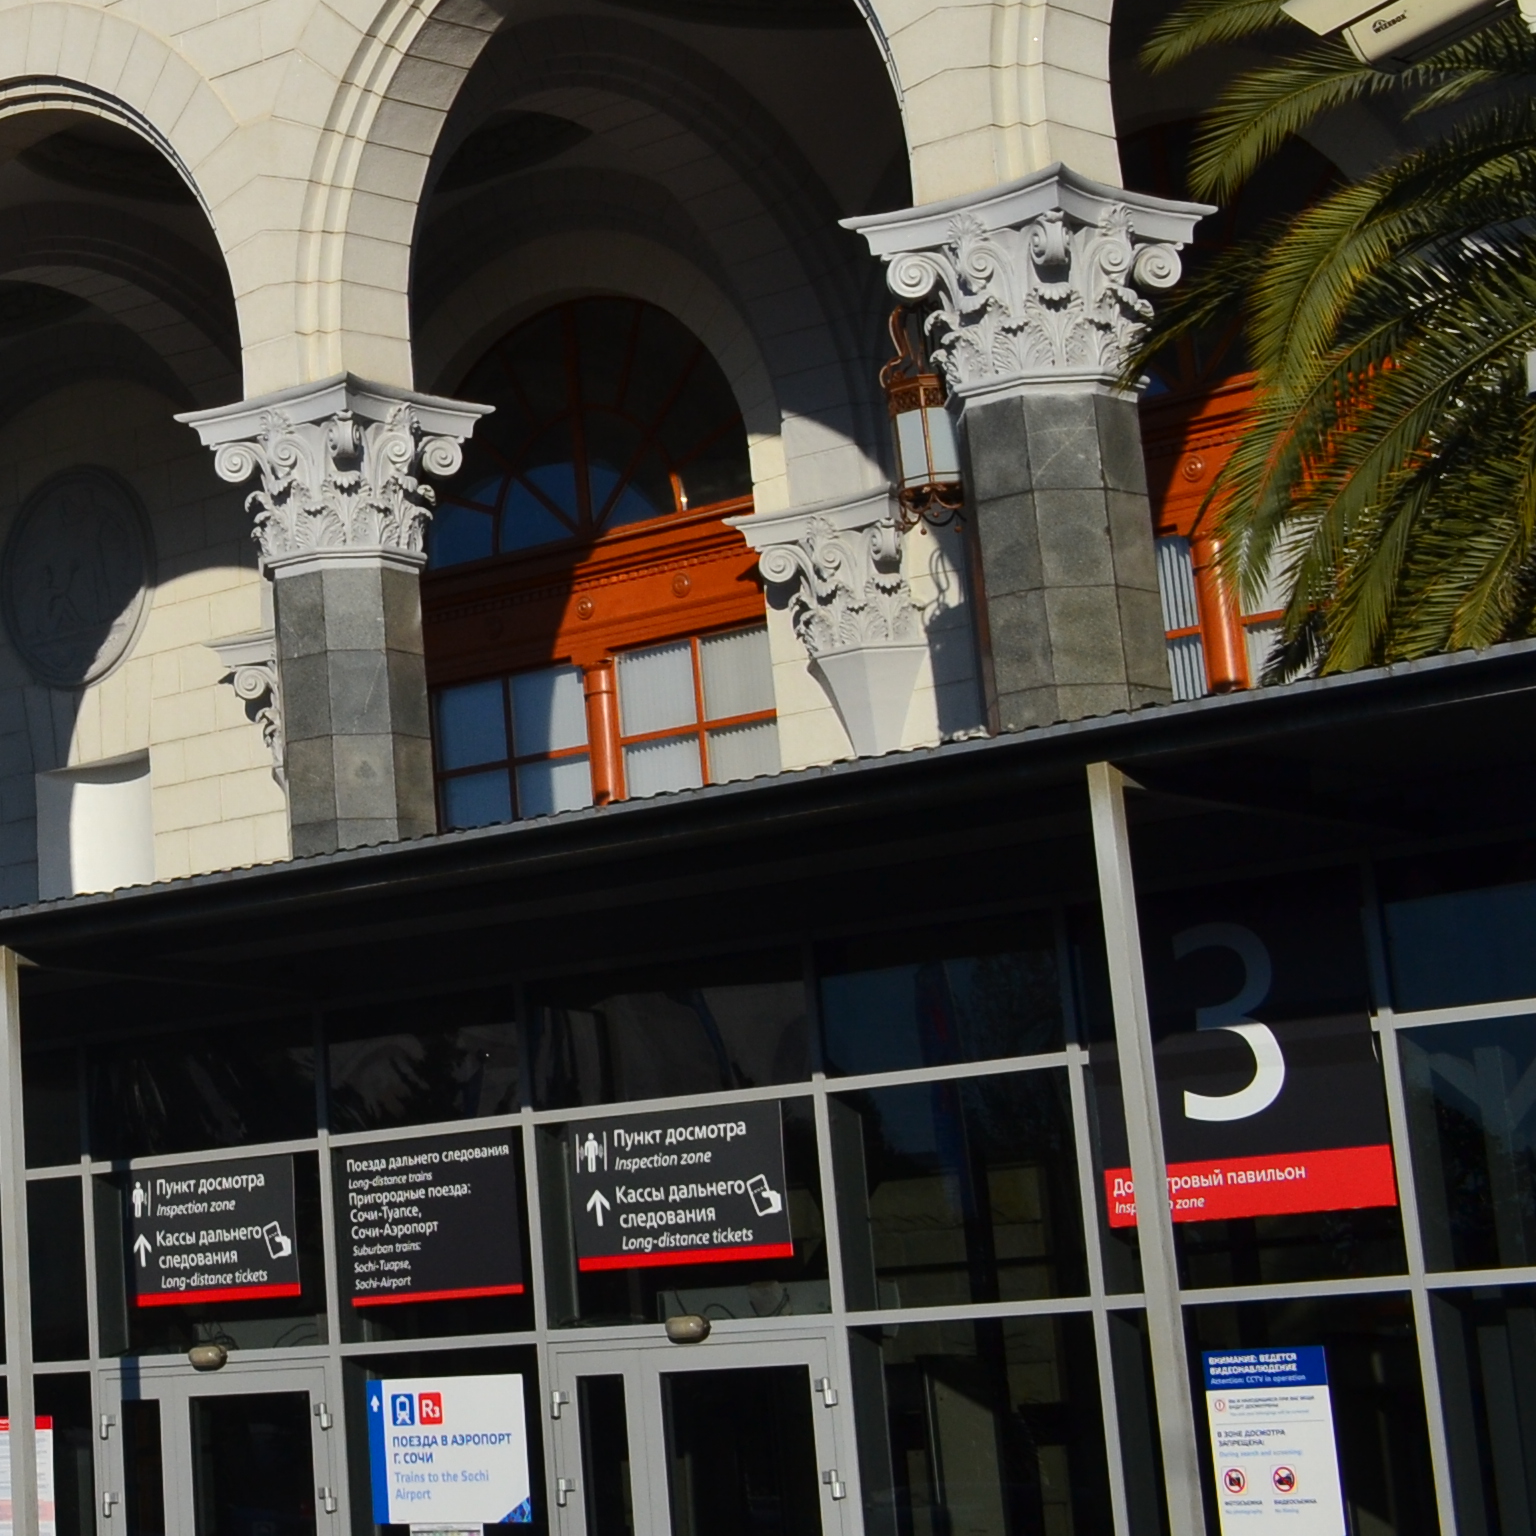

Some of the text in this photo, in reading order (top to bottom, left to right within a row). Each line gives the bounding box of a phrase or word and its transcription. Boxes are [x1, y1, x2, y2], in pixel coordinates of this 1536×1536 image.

[1172, 921, 1286, 1122] 3
[614, 1121, 746, 1151] Пункт досмотра
[346, 1144, 509, 1173] Поезда дальнего следования
[615, 1151, 712, 1173] Inspection zone
[348, 1171, 433, 1190] Long-distance trains
[1227, 1165, 1306, 1185] павильон
[156, 1173, 265, 1199] Пункт досмотра
[349, 1183, 472, 1207] Пригородные поезда:
[616, 1179, 745, 1204] Кассы дальнего
[156, 1199, 236, 1218] Inspection zone
[1176, 1196, 1205, 1210] zone
[350, 1205, 422, 1223] Сочи-Туапсе,
[619, 1207, 716, 1229] следования
[156, 1225, 262, 1246] Кассы дальнего
[351, 1220, 439, 1239] Сочи-Аэропорт
[353, 1241, 422, 1257] Suburban trains:
[622, 1227, 753, 1252] Long-distance tickets
[159, 1250, 238, 1269] следования
[354, 1259, 411, 1274] Sochi-Tuapse,
[161, 1269, 268, 1290] Long-distance tickets
[355, 1276, 412, 1290] Sochi-Airport
[422, 1400, 440, 1418] R3
[393, 1433, 512, 1448] ПОЕЗДА В АЭРОПОРТ
[394, 1452, 433, 1464] Г. СОЧИ
[395, 1470, 489, 1483] Trains to the Sochi
[395, 1489, 431, 1501] Airport
